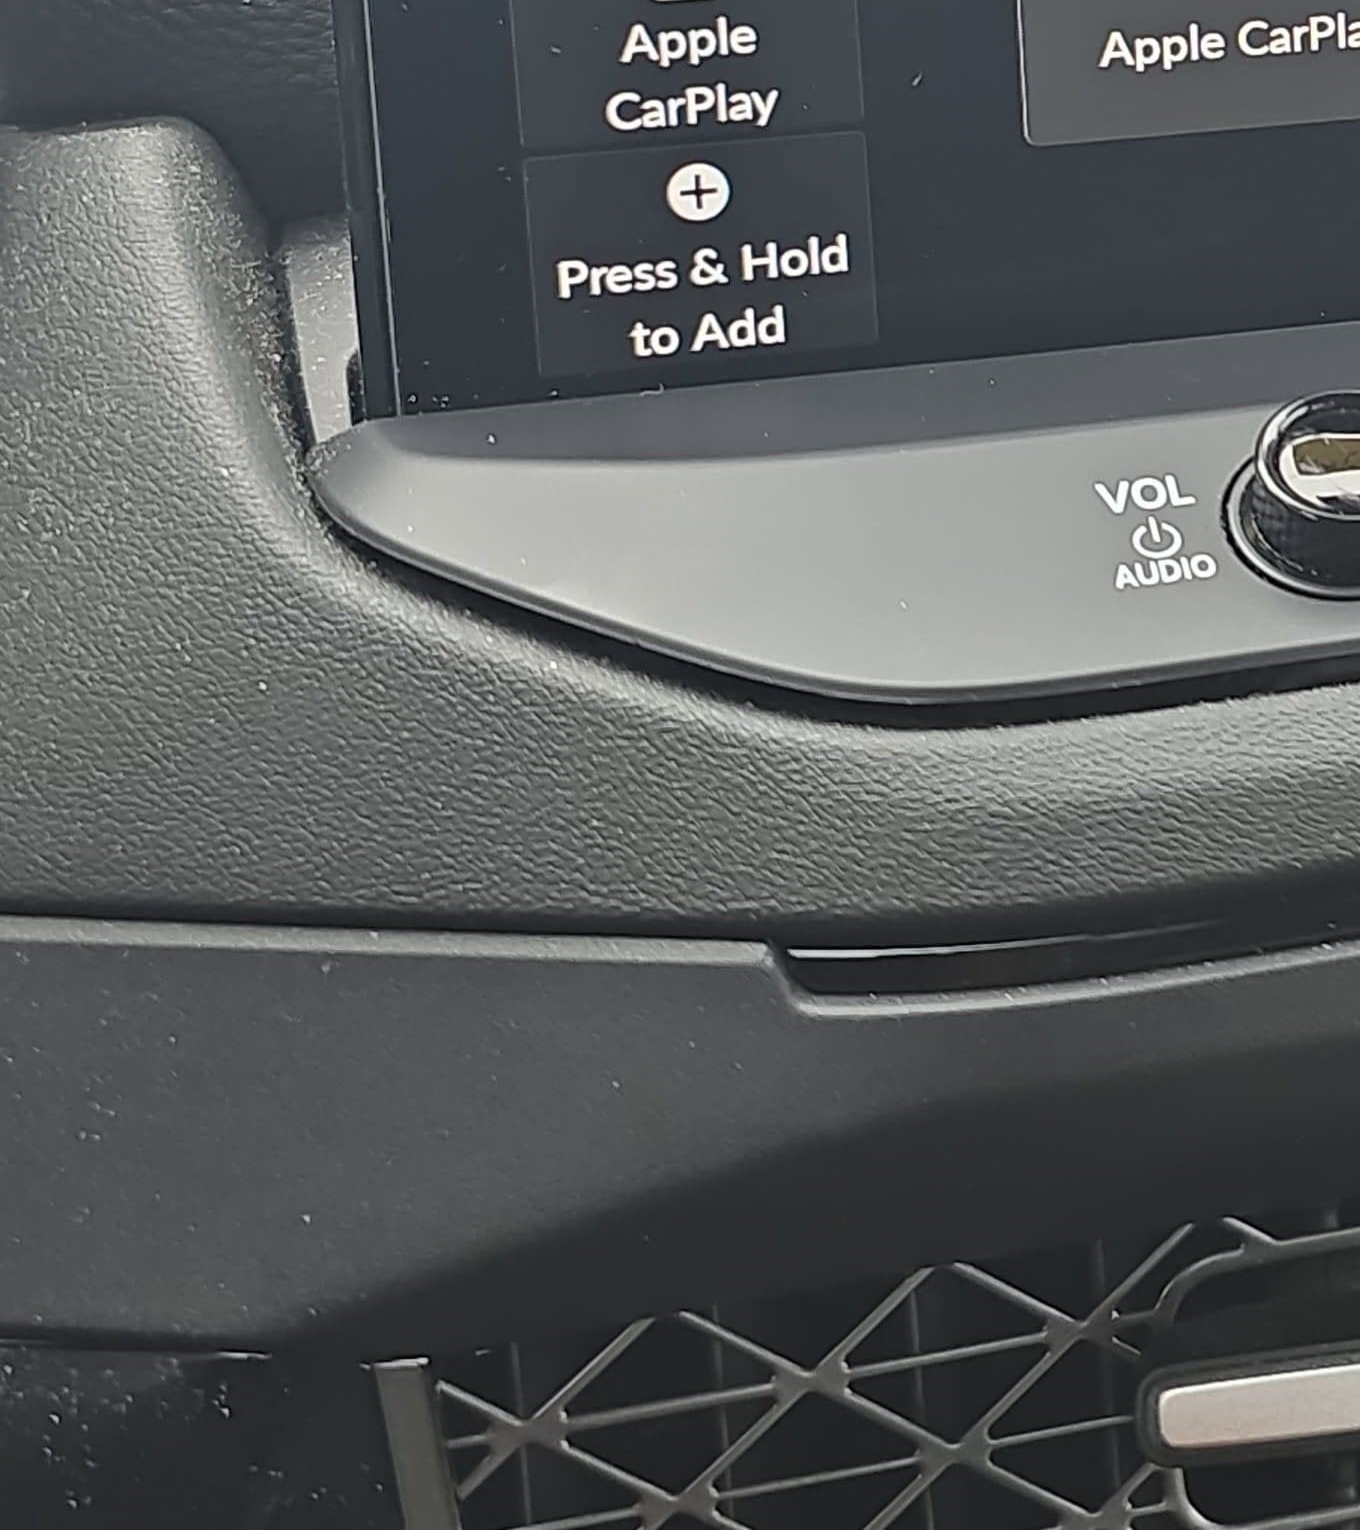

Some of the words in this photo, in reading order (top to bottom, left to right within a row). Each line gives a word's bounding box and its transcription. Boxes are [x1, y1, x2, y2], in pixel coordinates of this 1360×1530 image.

[619, 15, 758, 68] Apple
[1098, 22, 1227, 72] Apple
[605, 81, 780, 132] CarPlay
[556, 259, 679, 300] Press
[689, 247, 730, 287] &
[740, 232, 850, 282] Hold
[628, 321, 681, 358] to
[690, 304, 787, 353] Add
[1094, 473, 1197, 514] VOL
[1115, 553, 1217, 590] AUDIO
